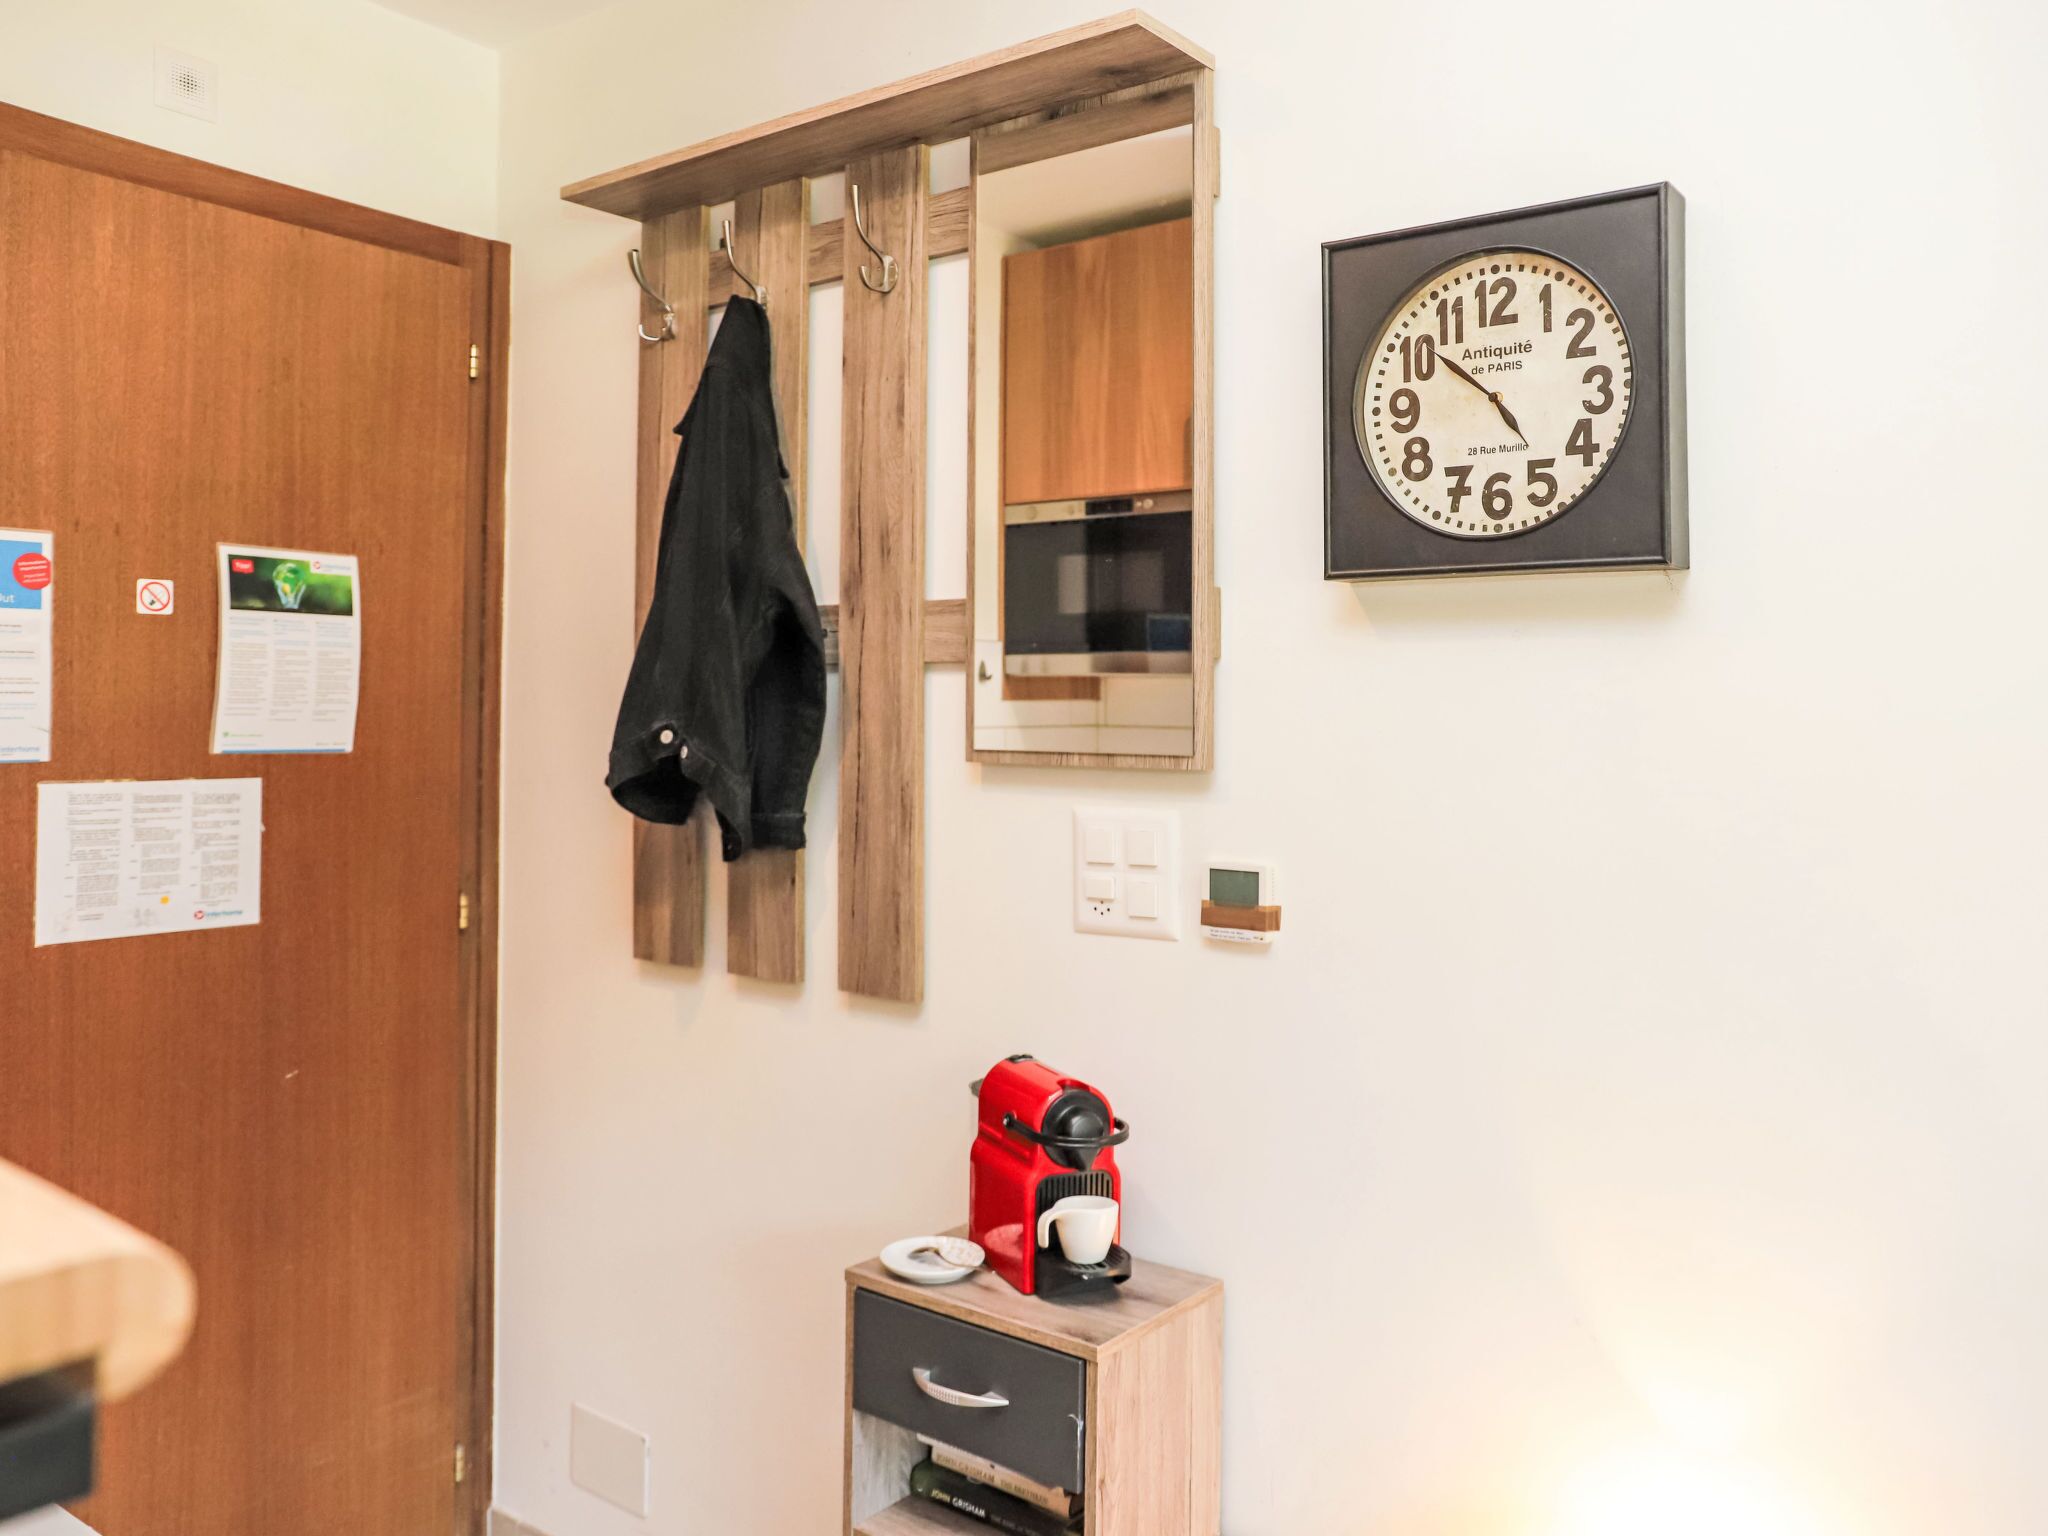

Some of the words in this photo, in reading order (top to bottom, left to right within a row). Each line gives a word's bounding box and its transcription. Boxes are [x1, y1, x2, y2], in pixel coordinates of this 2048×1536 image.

[1436, 295, 1464, 345] 11
[1475, 276, 1518, 329] 12
[1539, 283, 1552, 333] 1
[1462, 339, 1533, 360] Antiquité
[1565, 307, 1597, 359] 2
[1400, 334, 1436, 383] 10
[1471, 366, 1485, 375] de
[1487, 360, 1523, 373] PARIS
[1389, 388, 1420, 433] 9
[1581, 364, 1614, 415] 3
[1401, 436, 1433, 482] 8
[1467, 447, 1478, 456] 28
[1480, 446, 1497, 454] Rue
[1564, 418, 1600, 467] 4
[1444, 464, 1474, 513] 7
[1481, 472, 1513, 520] 6
[1526, 457, 1559, 508] 5
[931, 1488, 951, 1503] JOHN
[952, 1496, 986, 1518] GRISHAM
